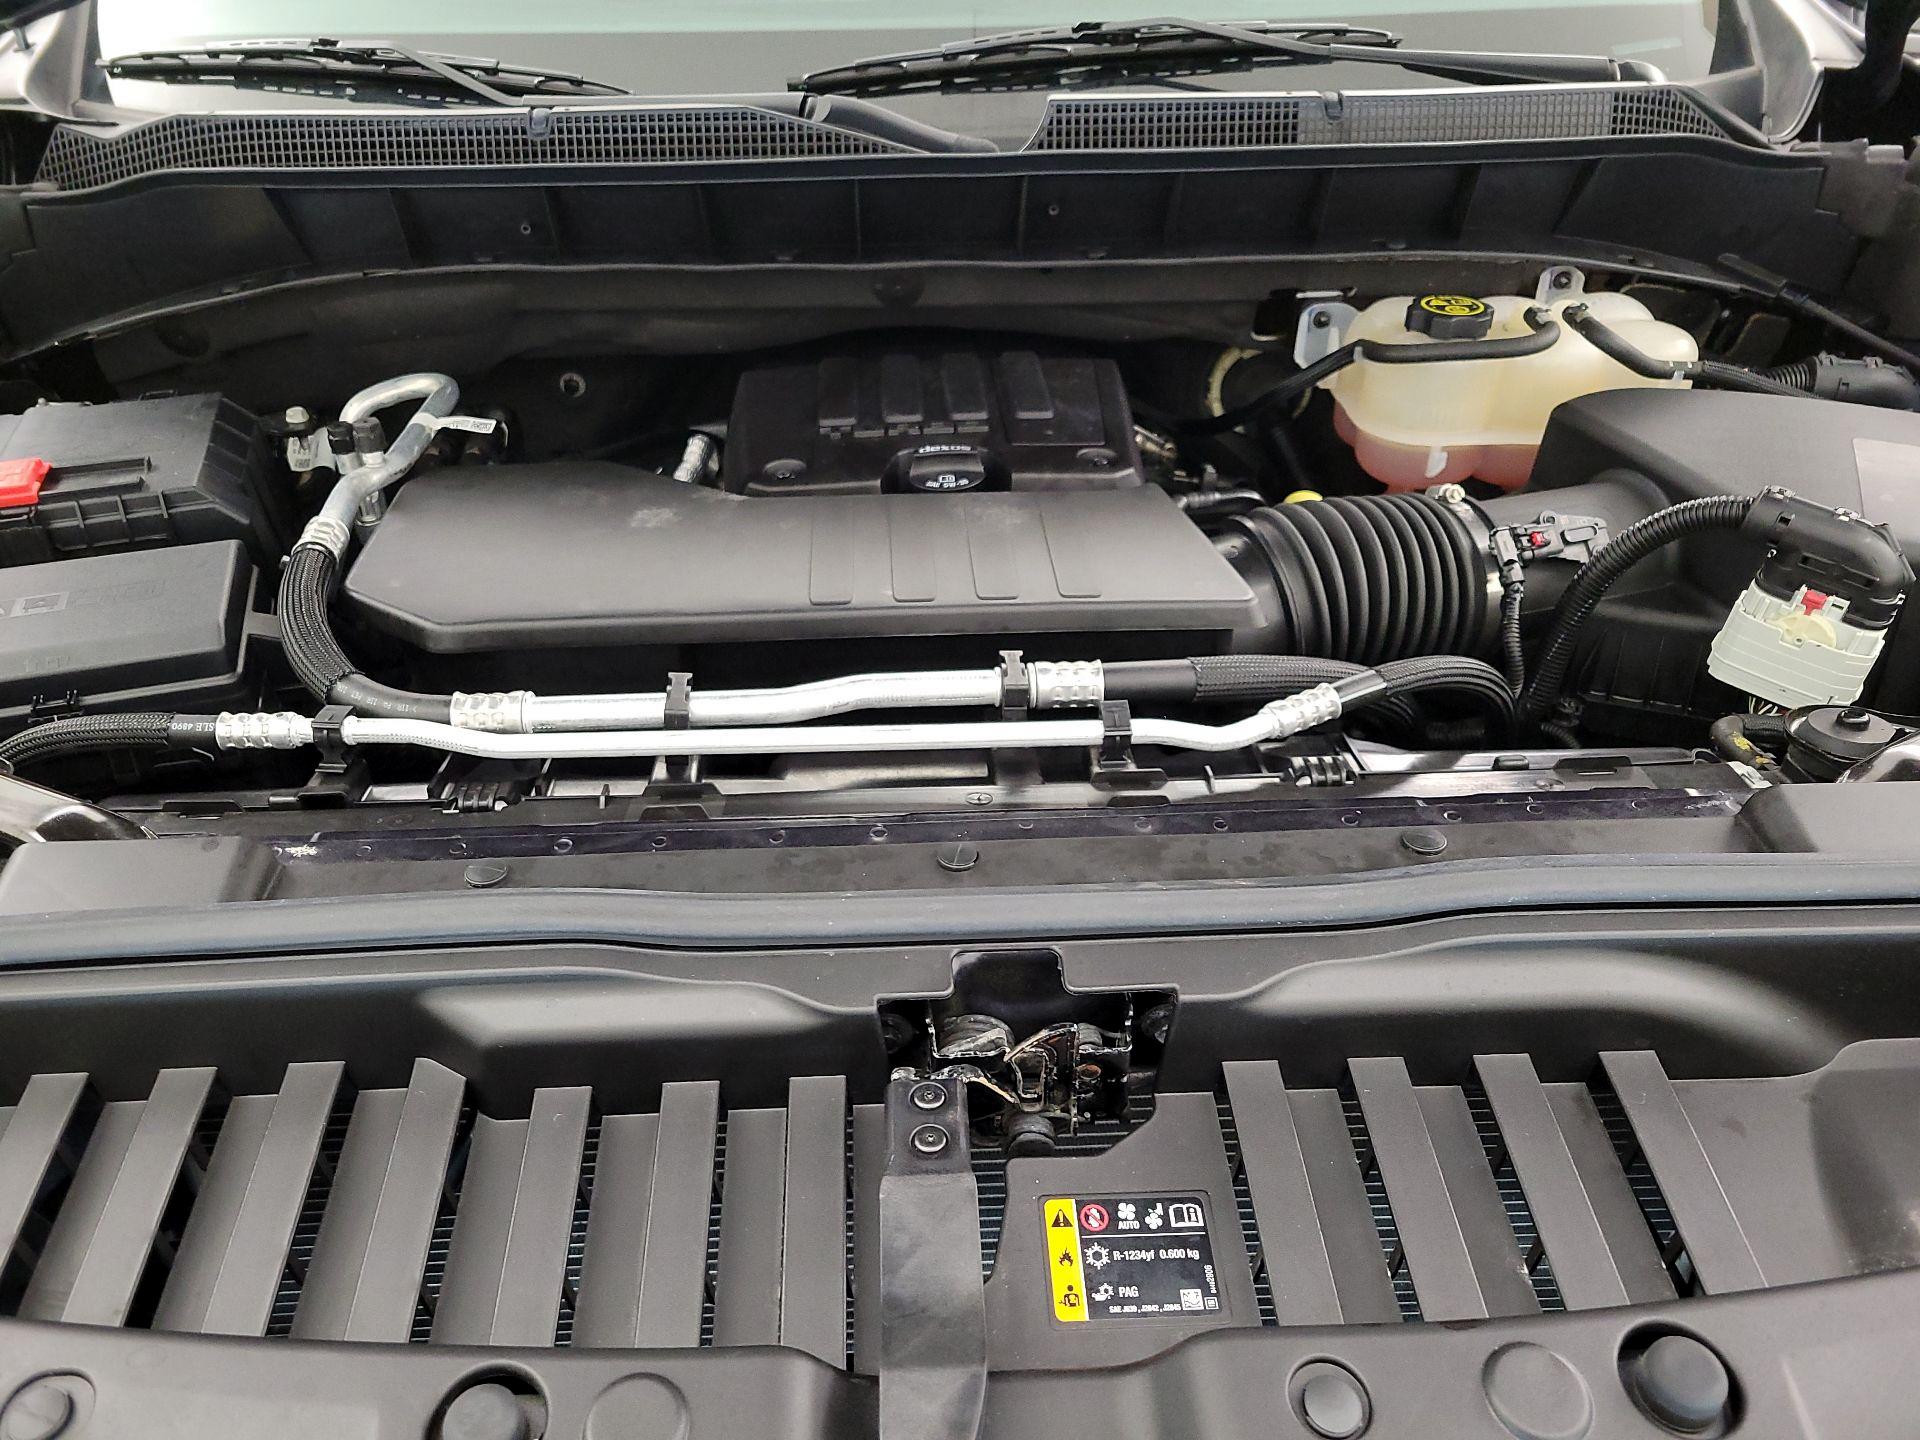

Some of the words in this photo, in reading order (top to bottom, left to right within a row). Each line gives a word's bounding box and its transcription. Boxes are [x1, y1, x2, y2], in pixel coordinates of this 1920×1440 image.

[919, 445, 971, 454] dexos
[171, 722, 194, 730] 4890
[196, 722, 215, 732] SLE
[1117, 1220, 1140, 1230] AUTO
[1113, 1247, 1155, 1262] R-1234yf
[1159, 1248, 1185, 1259] 0.600
[1187, 1247, 1200, 1261] kg
[1118, 1286, 1140, 1298] PAG
